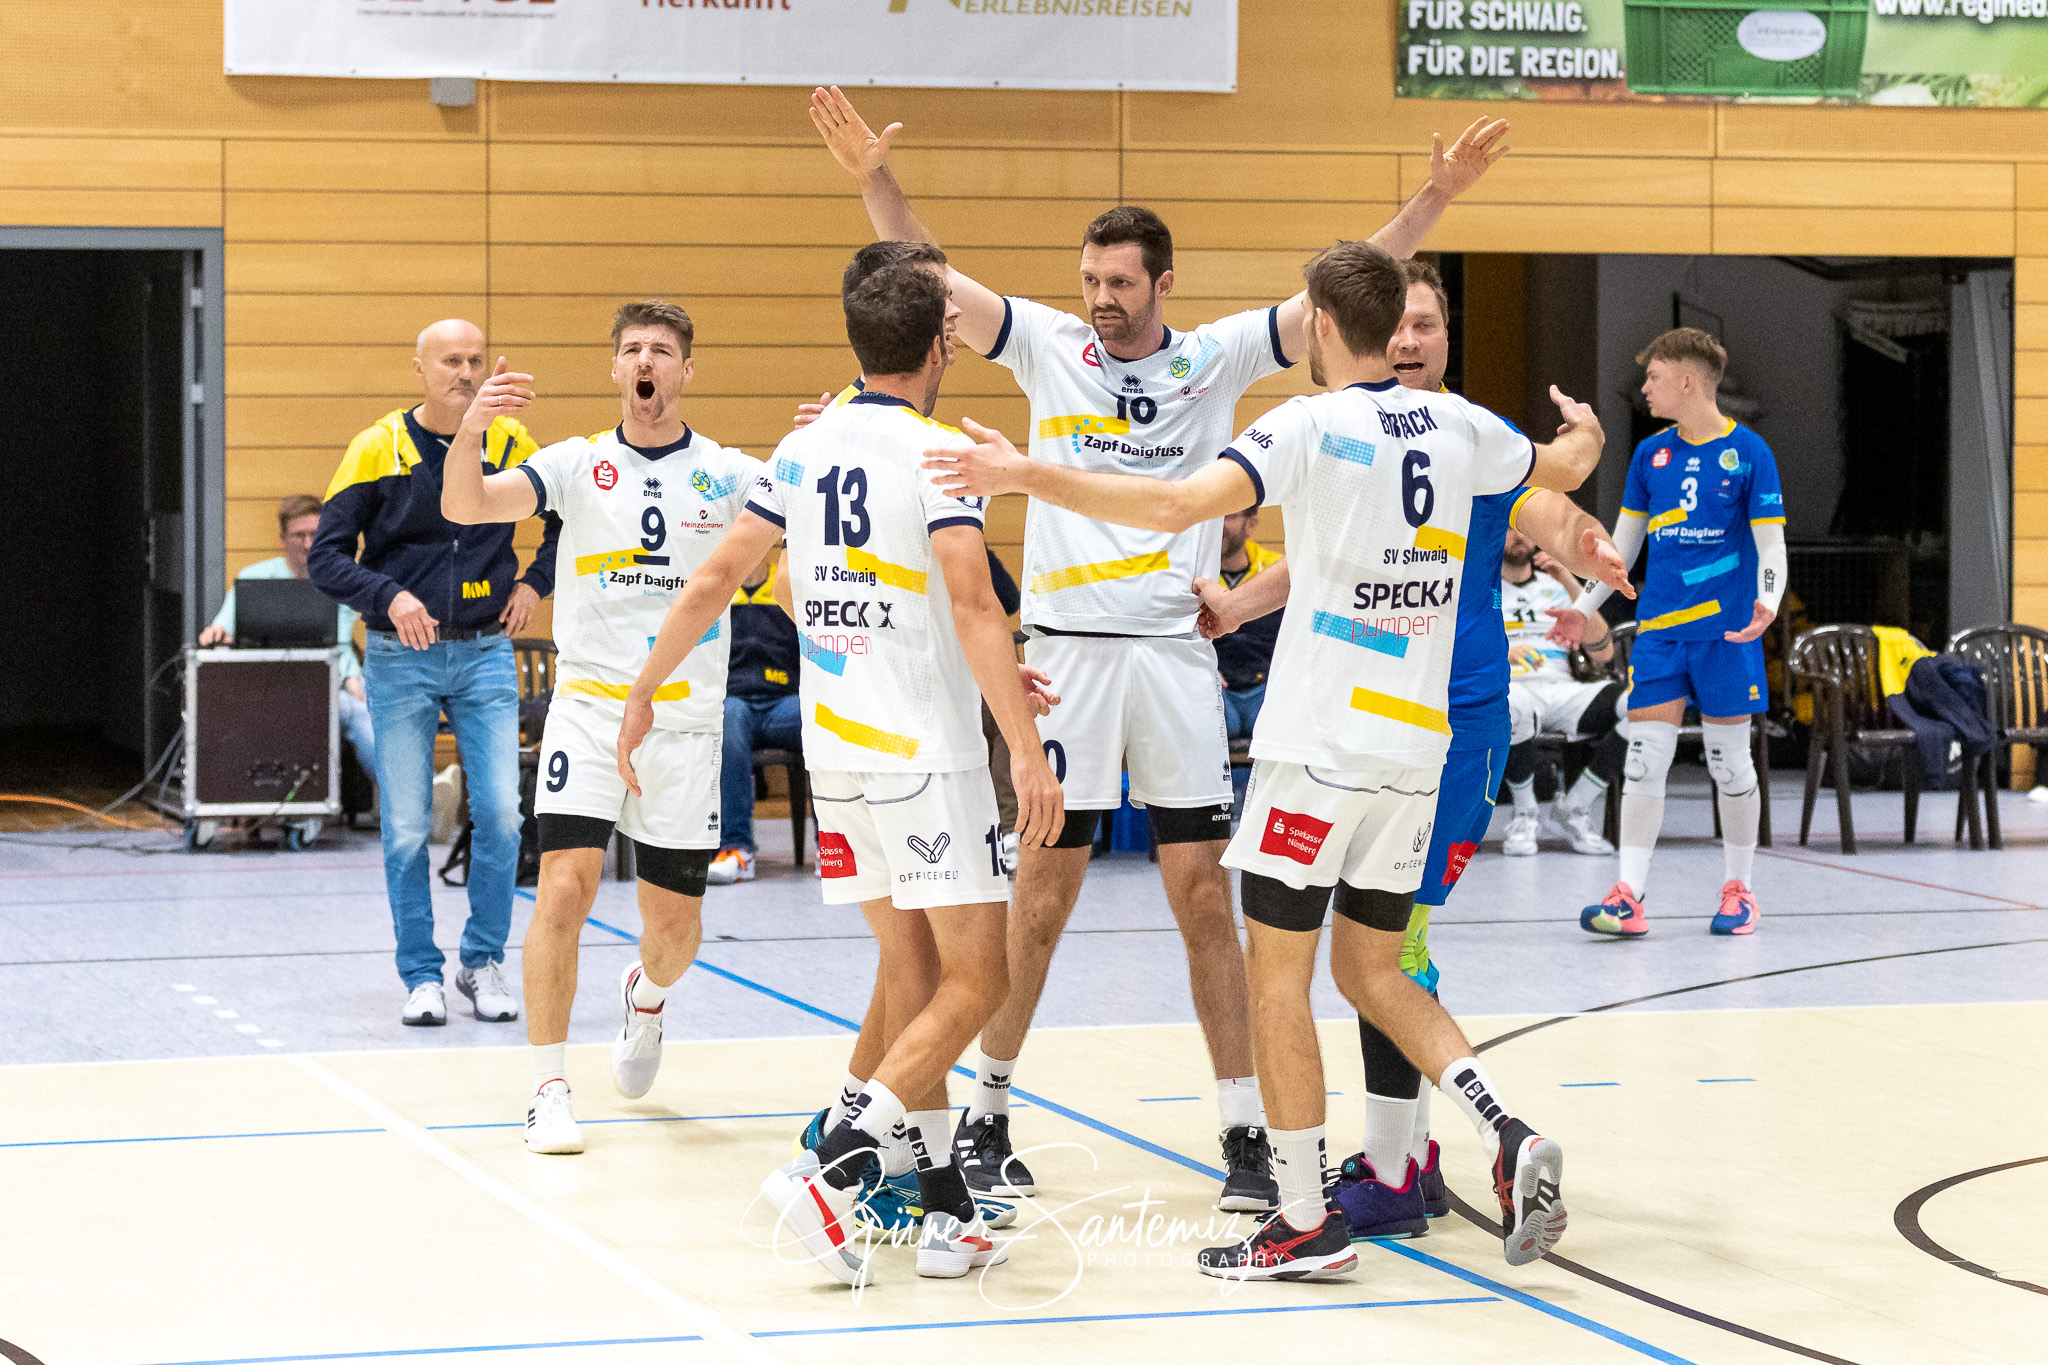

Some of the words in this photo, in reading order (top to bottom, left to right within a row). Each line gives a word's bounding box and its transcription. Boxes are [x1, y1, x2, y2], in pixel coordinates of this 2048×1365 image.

[1469, 1, 1588, 32] SCHWAIG.
[1408, 38, 1464, 75] FÜR
[1470, 46, 1515, 76] DIE
[1521, 46, 1625, 78] REGION.
[1117, 395, 1157, 425] 10
[1084, 435, 1118, 452] Zapf
[1121, 443, 1183, 458] Daigfuss
[643, 490, 662, 499] errea
[1402, 450, 1434, 528] 6
[1679, 476, 1698, 512] 3
[817, 466, 871, 548] 13
[641, 506, 666, 551] 9
[681, 521, 724, 529] Heinzelmann
[1383, 548, 1399, 564] SV
[609, 571, 642, 586] Zapf
[815, 566, 827, 581] SV
[1353, 579, 1441, 610] SPECK
[805, 600, 869, 628] SPECK
[1514, 608, 1536, 622] 11
[806, 634, 873, 661] pumpen
[546, 751, 569, 792] 9
